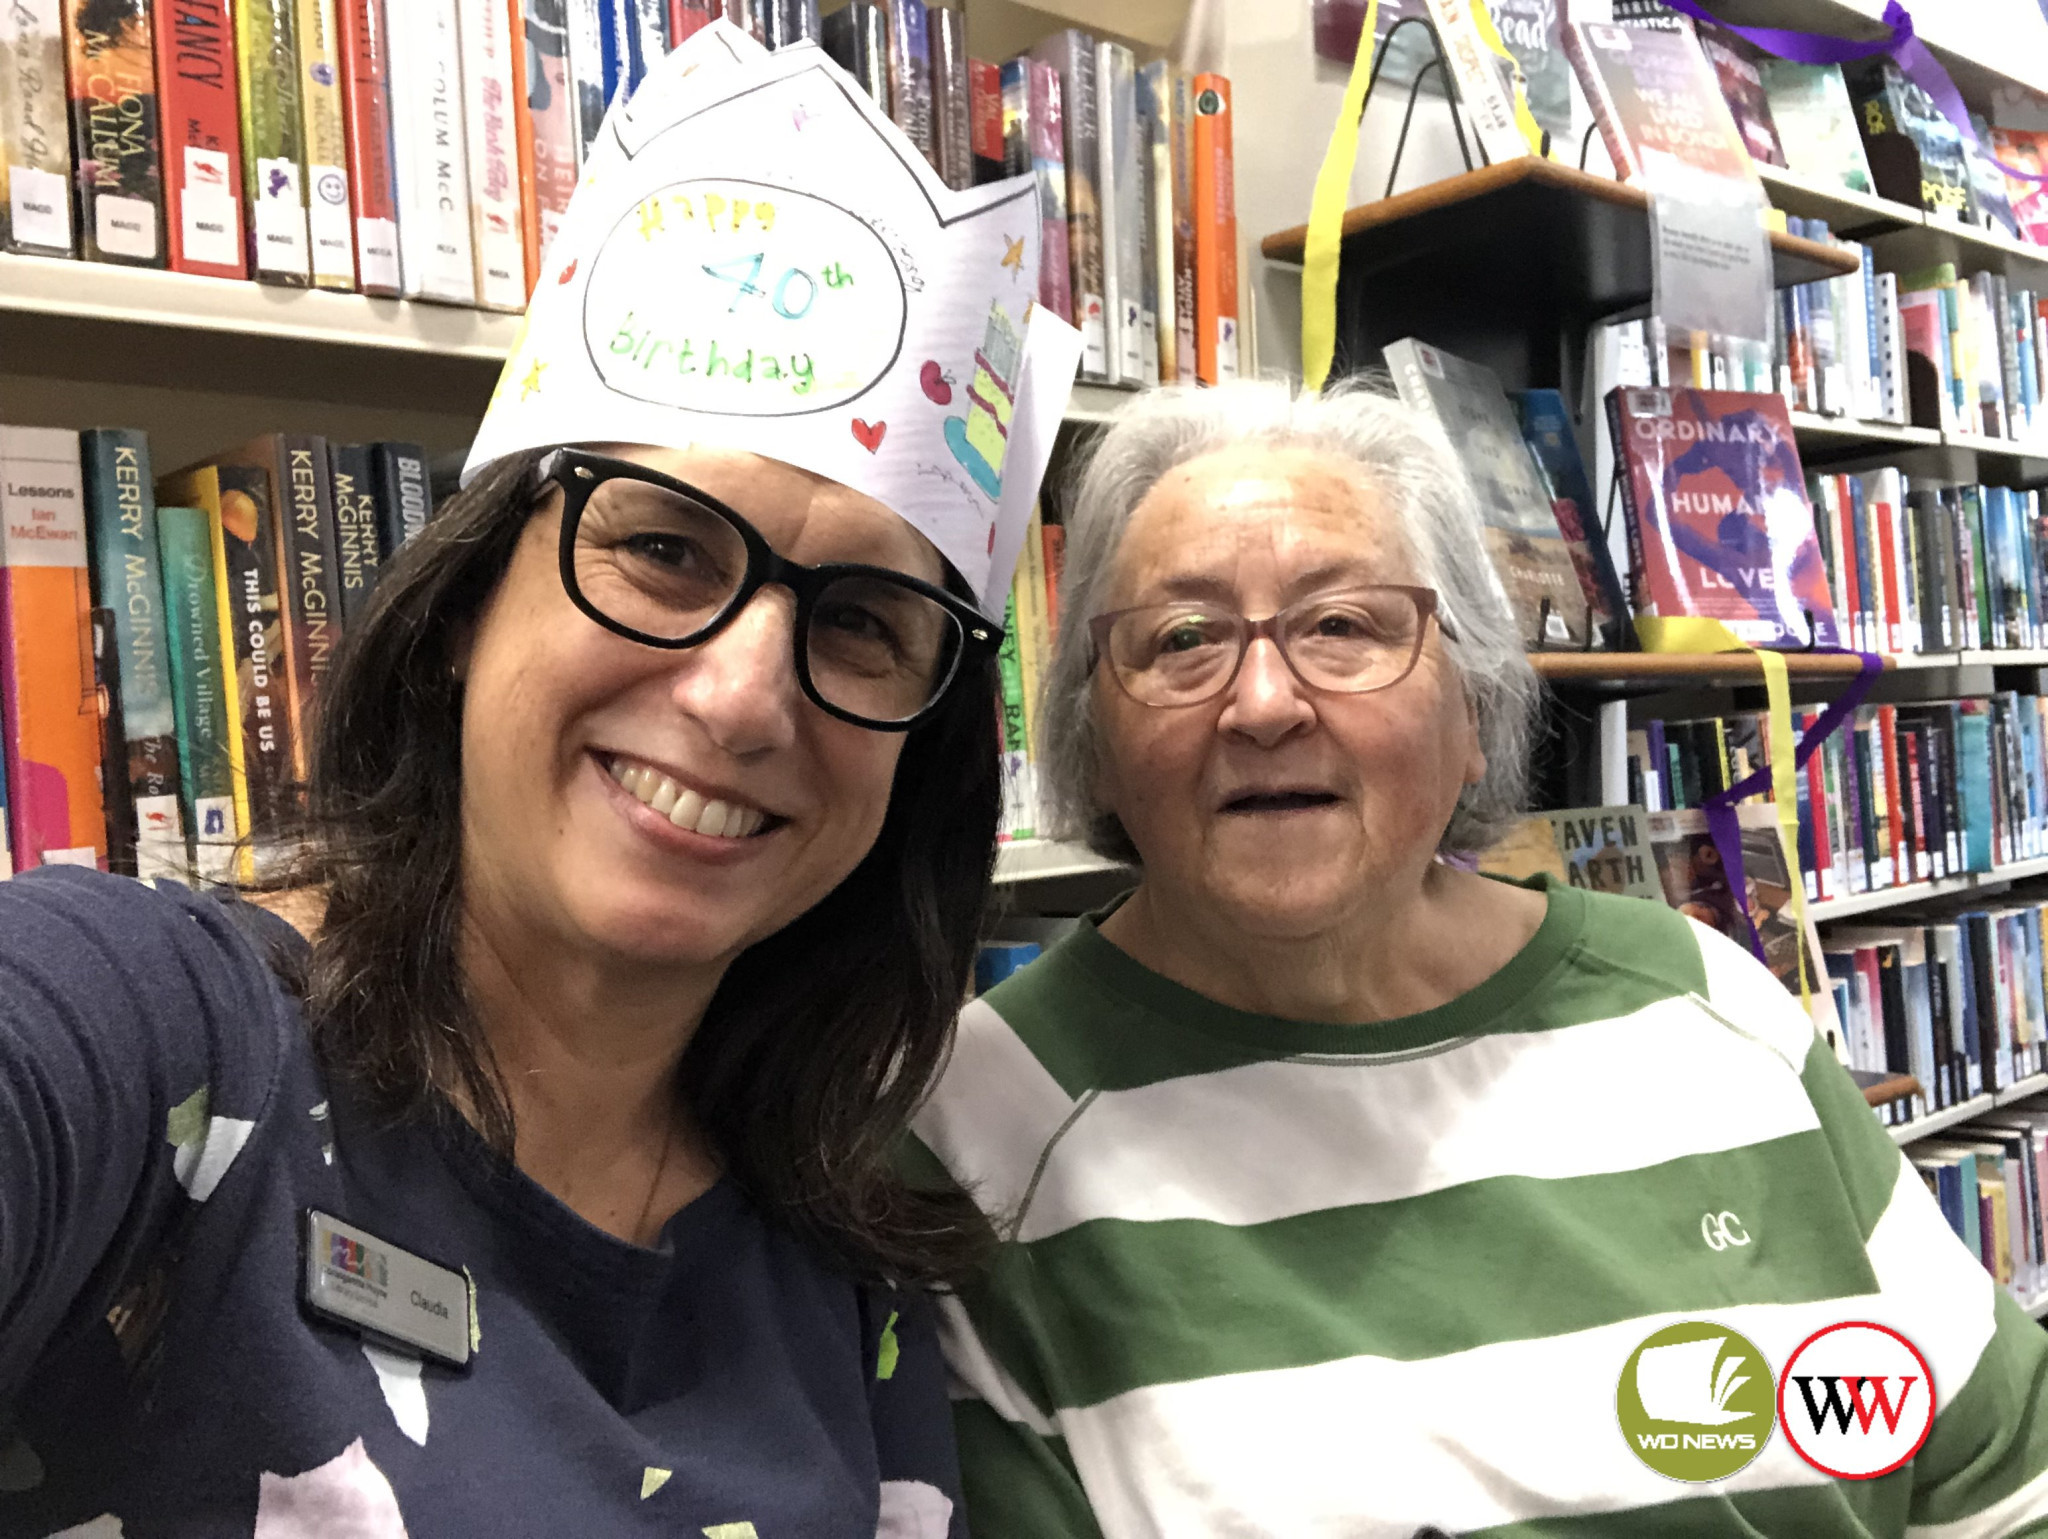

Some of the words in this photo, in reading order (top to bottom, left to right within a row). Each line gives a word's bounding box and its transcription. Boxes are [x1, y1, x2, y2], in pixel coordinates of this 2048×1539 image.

[115, 71, 146, 156] FIONA
[435, 158, 455, 212] McC
[1635, 418, 1781, 446] ORDINARY
[7, 482, 75, 499] Lessons
[114, 446, 144, 542] KERRY
[290, 448, 320, 540] KERRY
[31, 507, 56, 521] Ian
[334, 472, 364, 590] McGINNIS
[357, 494, 378, 568] KERRY
[9, 525, 79, 541] McEwan
[243, 568, 261, 613] THIS
[1699, 566, 1775, 590] LOVE
[248, 619, 268, 688] COULD
[255, 695, 271, 719] BE
[258, 725, 276, 752] US
[146, 771, 165, 796] Ro
[1551, 815, 1638, 850] AVEN
[1568, 855, 1645, 888] ARTH
[1701, 1210, 1751, 1251] GC
[410, 1289, 449, 1320] Claudia
